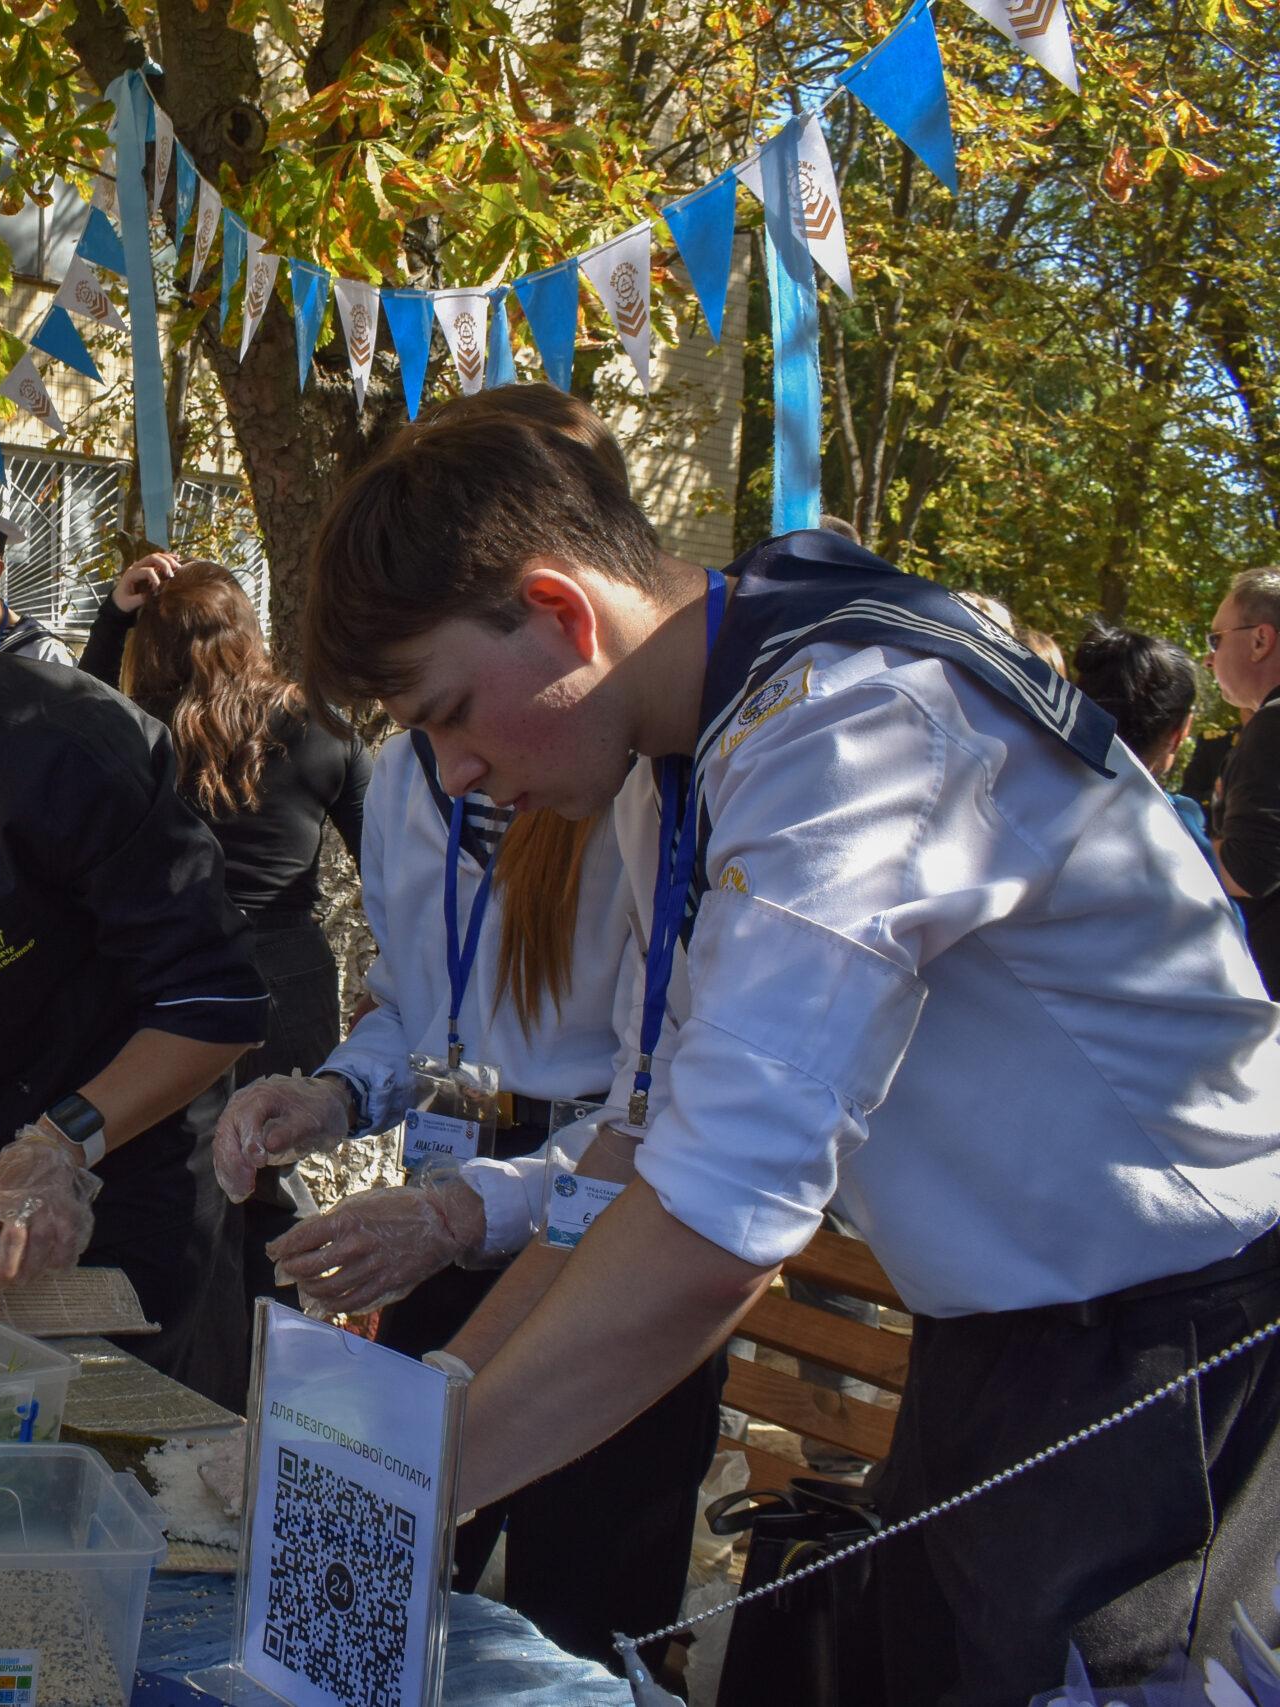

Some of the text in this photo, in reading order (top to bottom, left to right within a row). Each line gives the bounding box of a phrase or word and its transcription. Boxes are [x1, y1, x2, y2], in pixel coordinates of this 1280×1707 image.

[270, 1400, 432, 1492] ДЛЯ БЕЗГОТІВКОВОЇ СПЛАТИ
[328, 1573, 349, 1602] 24
